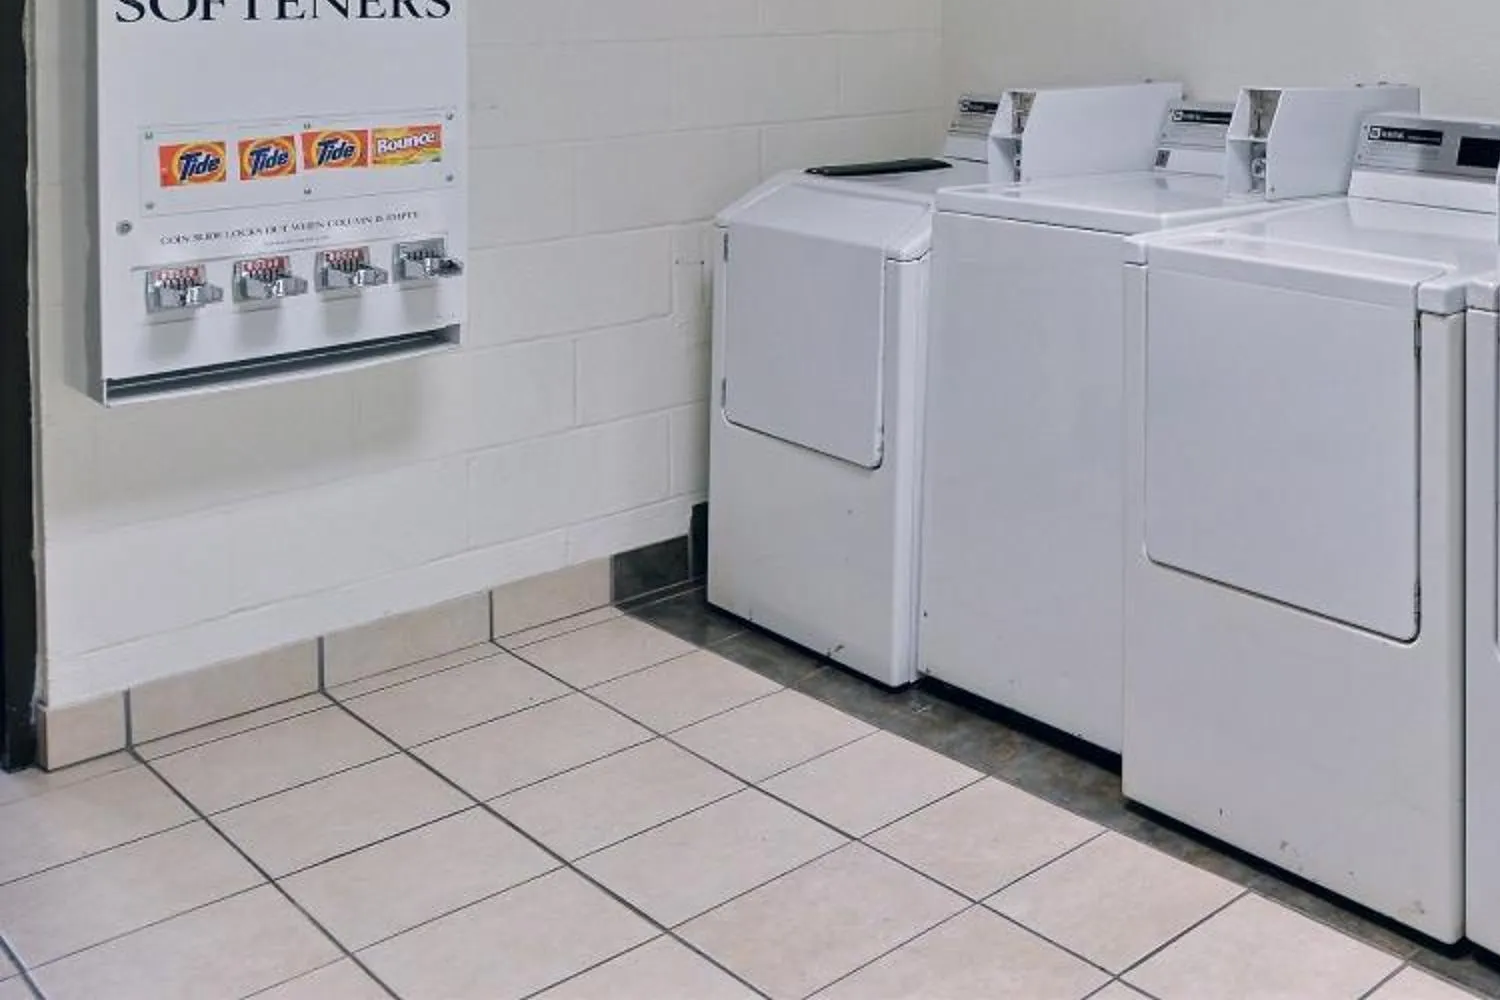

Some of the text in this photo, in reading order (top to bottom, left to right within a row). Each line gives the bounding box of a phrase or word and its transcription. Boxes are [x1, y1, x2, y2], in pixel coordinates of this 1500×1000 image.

[317, 138, 355, 167] Tide
[376, 132, 435, 154] Bounce
[179, 150, 221, 181] Tide
[249, 146, 288, 176] Tide
